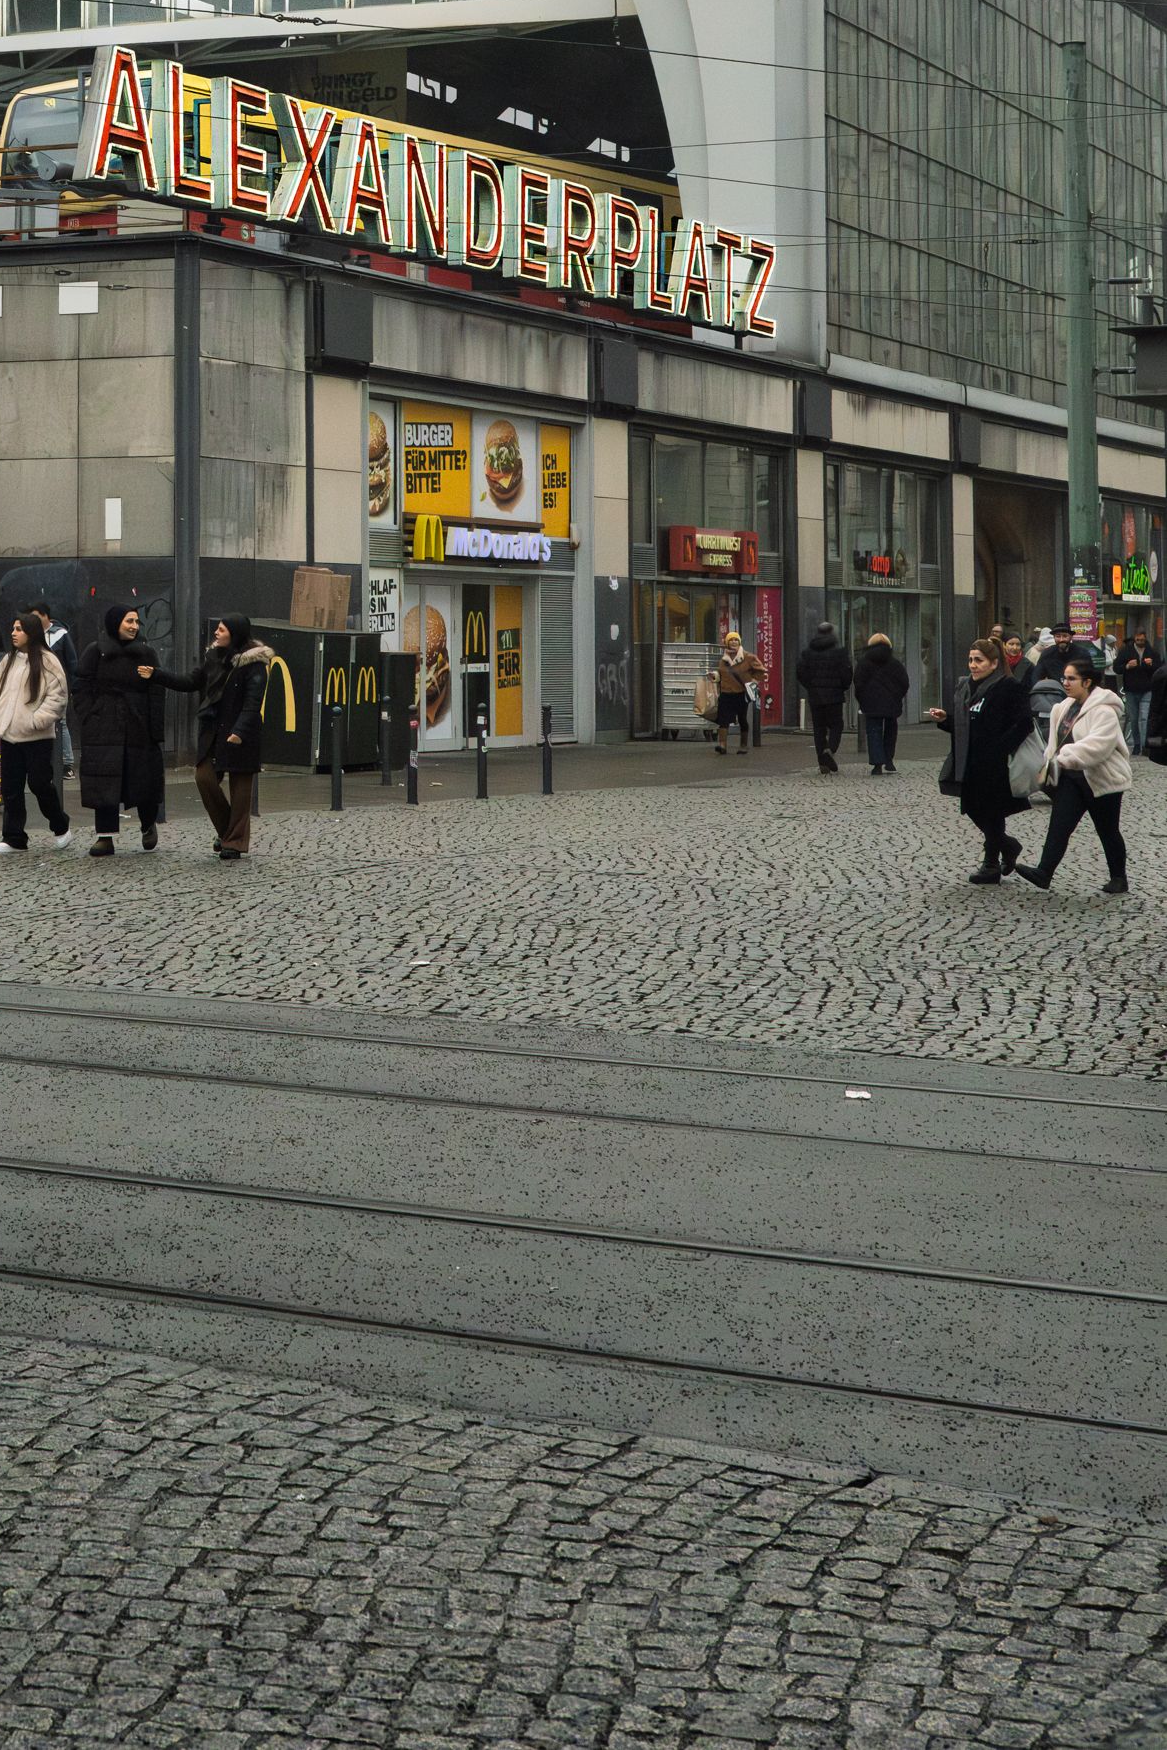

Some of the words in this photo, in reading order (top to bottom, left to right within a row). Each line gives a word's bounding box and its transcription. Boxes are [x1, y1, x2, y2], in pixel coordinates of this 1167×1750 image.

[80, 44, 777, 338] ALEXANDERPLATZ
[404, 423, 453, 447] BURGER
[428, 452, 468, 471] MITTE?
[542, 453, 558, 470] ICH
[405, 472, 441, 494] BITTE!
[542, 471, 567, 490] LIEBE
[542, 492, 557, 509] ES!
[446, 526, 552, 562] McDonald's
[368, 579, 397, 596] HLAF-
[377, 597, 387, 612] IN
